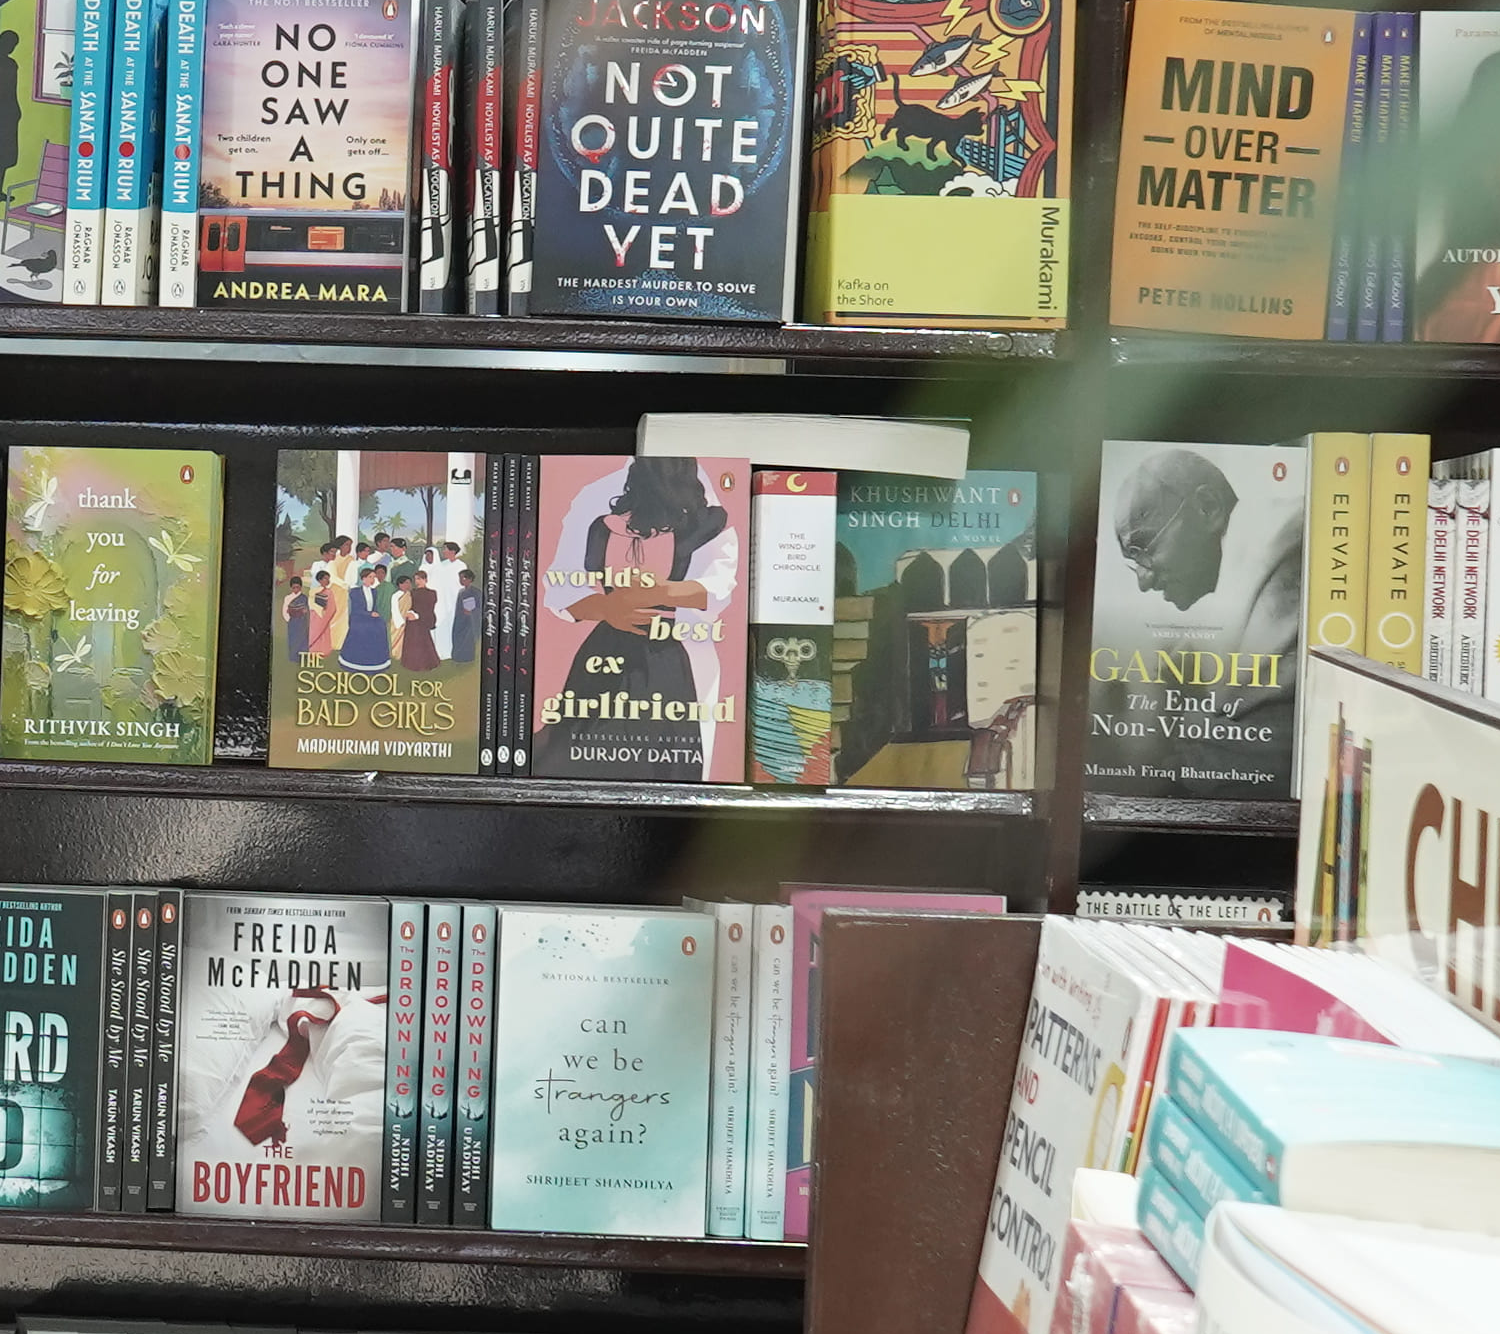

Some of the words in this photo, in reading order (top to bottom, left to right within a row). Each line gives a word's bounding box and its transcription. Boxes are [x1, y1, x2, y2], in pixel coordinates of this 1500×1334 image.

[275, 23, 337, 53] NO
[261, 59, 348, 89] ONE
[605, 62, 734, 106] NOT
[1161, 57, 1314, 120] MIND
[261, 98, 350, 126] SAW
[288, 137, 314, 162] A
[571, 115, 759, 163] QUITE
[1184, 125, 1279, 164] OVER
[236, 171, 367, 200] THING
[579, 170, 745, 217] DEAD
[1137, 165, 1316, 219] MATTER
[603, 226, 715, 270] YET
[1038, 206, 1062, 311] Murakami
[558, 277, 577, 288] THE
[581, 278, 637, 291] HARDEST
[642, 280, 693, 292] MURDER
[696, 281, 712, 293] TO
[716, 282, 756, 294] SOLVE
[838, 279, 869, 292] Kafka
[874, 282, 889, 292] on
[838, 293, 855, 305] the
[859, 293, 894, 307] Shore
[78, 488, 136, 509] thank
[86, 530, 125, 552] you
[778, 543, 816, 551] WIND-UP
[790, 532, 805, 540] THE
[1330, 491, 1349, 603] ELEVATE
[773, 563, 821, 572] CHRONICLE
[787, 553, 807, 562] BIRD
[91, 565, 120, 589] for
[546, 567, 656, 590] world's
[773, 595, 820, 604] MURAKAMI
[69, 602, 140, 630] leaving
[649, 615, 726, 644] best
[585, 654, 625, 675] ex
[1088, 647, 1282, 692] GANDHI
[297, 669, 404, 698] SCHOOL
[411, 679, 449, 699] FOR
[297, 698, 362, 729] BAD
[370, 701, 456, 732] GIRLS
[541, 693, 736, 726] girlfriend
[1128, 694, 1160, 713] The
[1164, 690, 1217, 714] End
[1221, 690, 1242, 715] of
[1092, 713, 1274, 744] Non-Violence
[580, 1016, 628, 1035] can
[562, 1052, 601, 1071] we
[613, 1049, 644, 1072] be
[1023, 997, 1104, 1096] PATTERNS
[533, 1068, 671, 1110] strangers
[559, 1123, 648, 1149] again?
[1001, 1111, 1057, 1199] PENCIL
[193, 1161, 367, 1210] BOYFRIEND
[990, 1185, 1056, 1294] CONTROL
